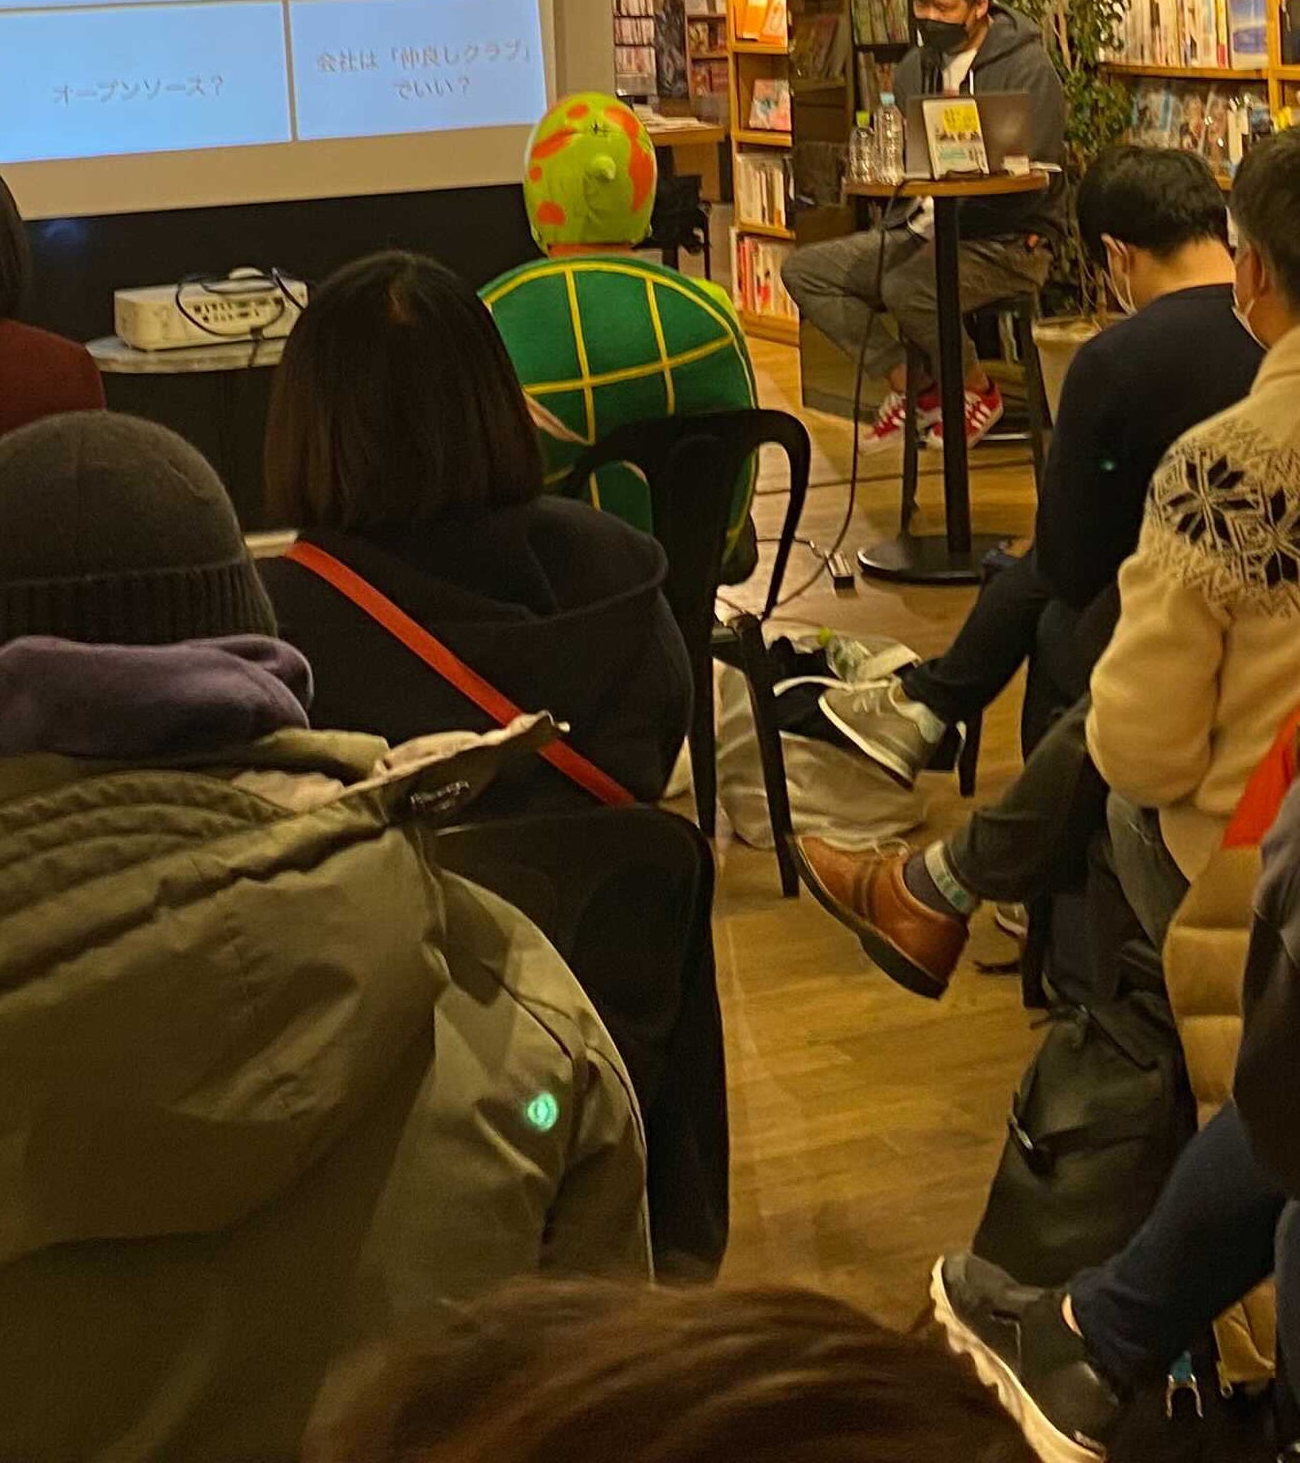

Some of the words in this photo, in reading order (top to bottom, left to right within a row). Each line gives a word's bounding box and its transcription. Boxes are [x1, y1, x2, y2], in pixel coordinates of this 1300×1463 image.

[52, 74, 224, 106] オープンソース？
[392, 77, 470, 100] でいい？
